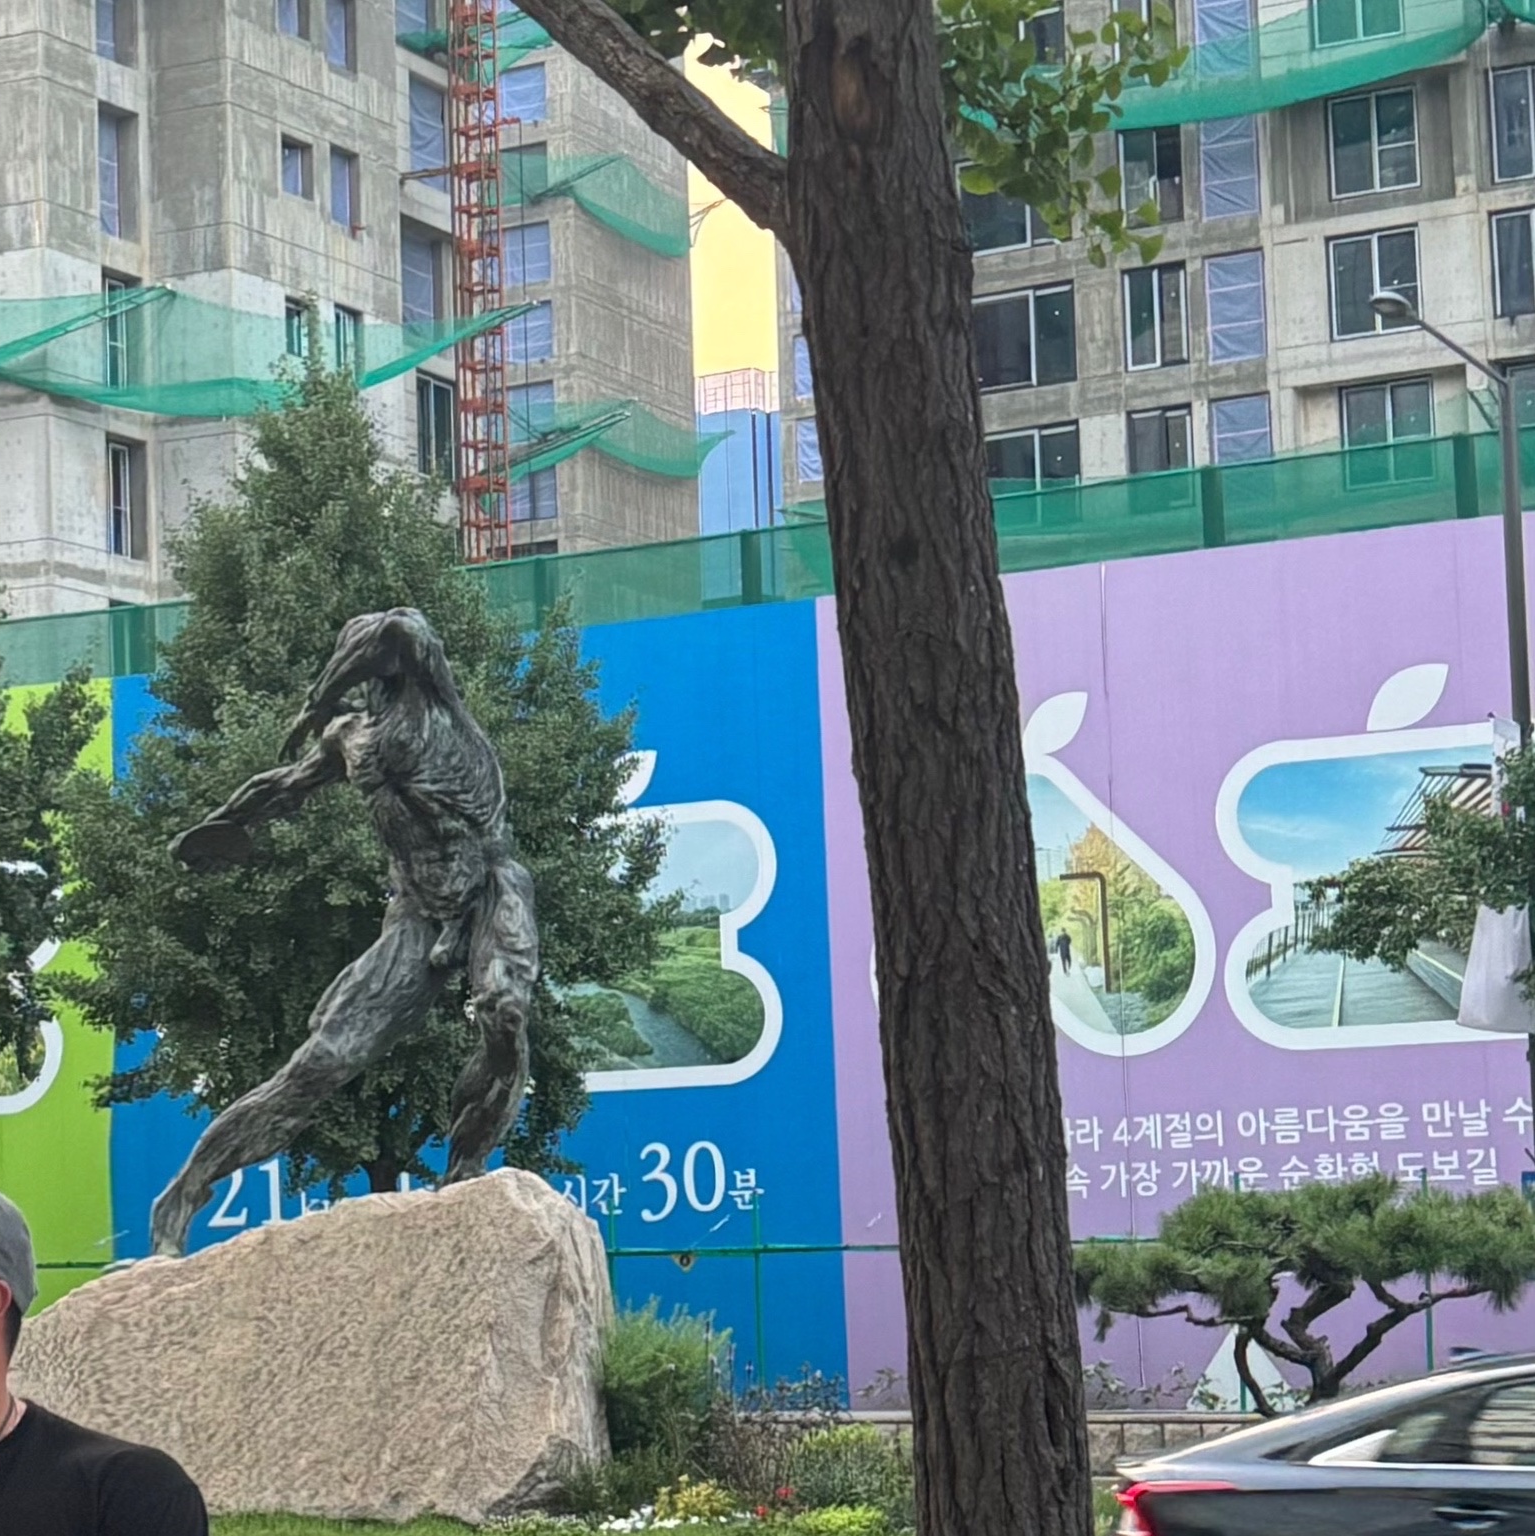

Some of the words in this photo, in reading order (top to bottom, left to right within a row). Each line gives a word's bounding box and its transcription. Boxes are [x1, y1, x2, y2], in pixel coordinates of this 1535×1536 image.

[1112, 1110, 1224, 1150] 4계절의
[1237, 1102, 1410, 1146] 아름다움을
[1422, 1098, 1491, 1138] 만날
[1502, 1097, 1533, 1135] 수
[640, 1141, 764, 1222] 30분
[1100, 1160, 1161, 1198] 가장
[1171, 1156, 1269, 1197] 가까운
[1397, 1147, 1499, 1185] 도보길
